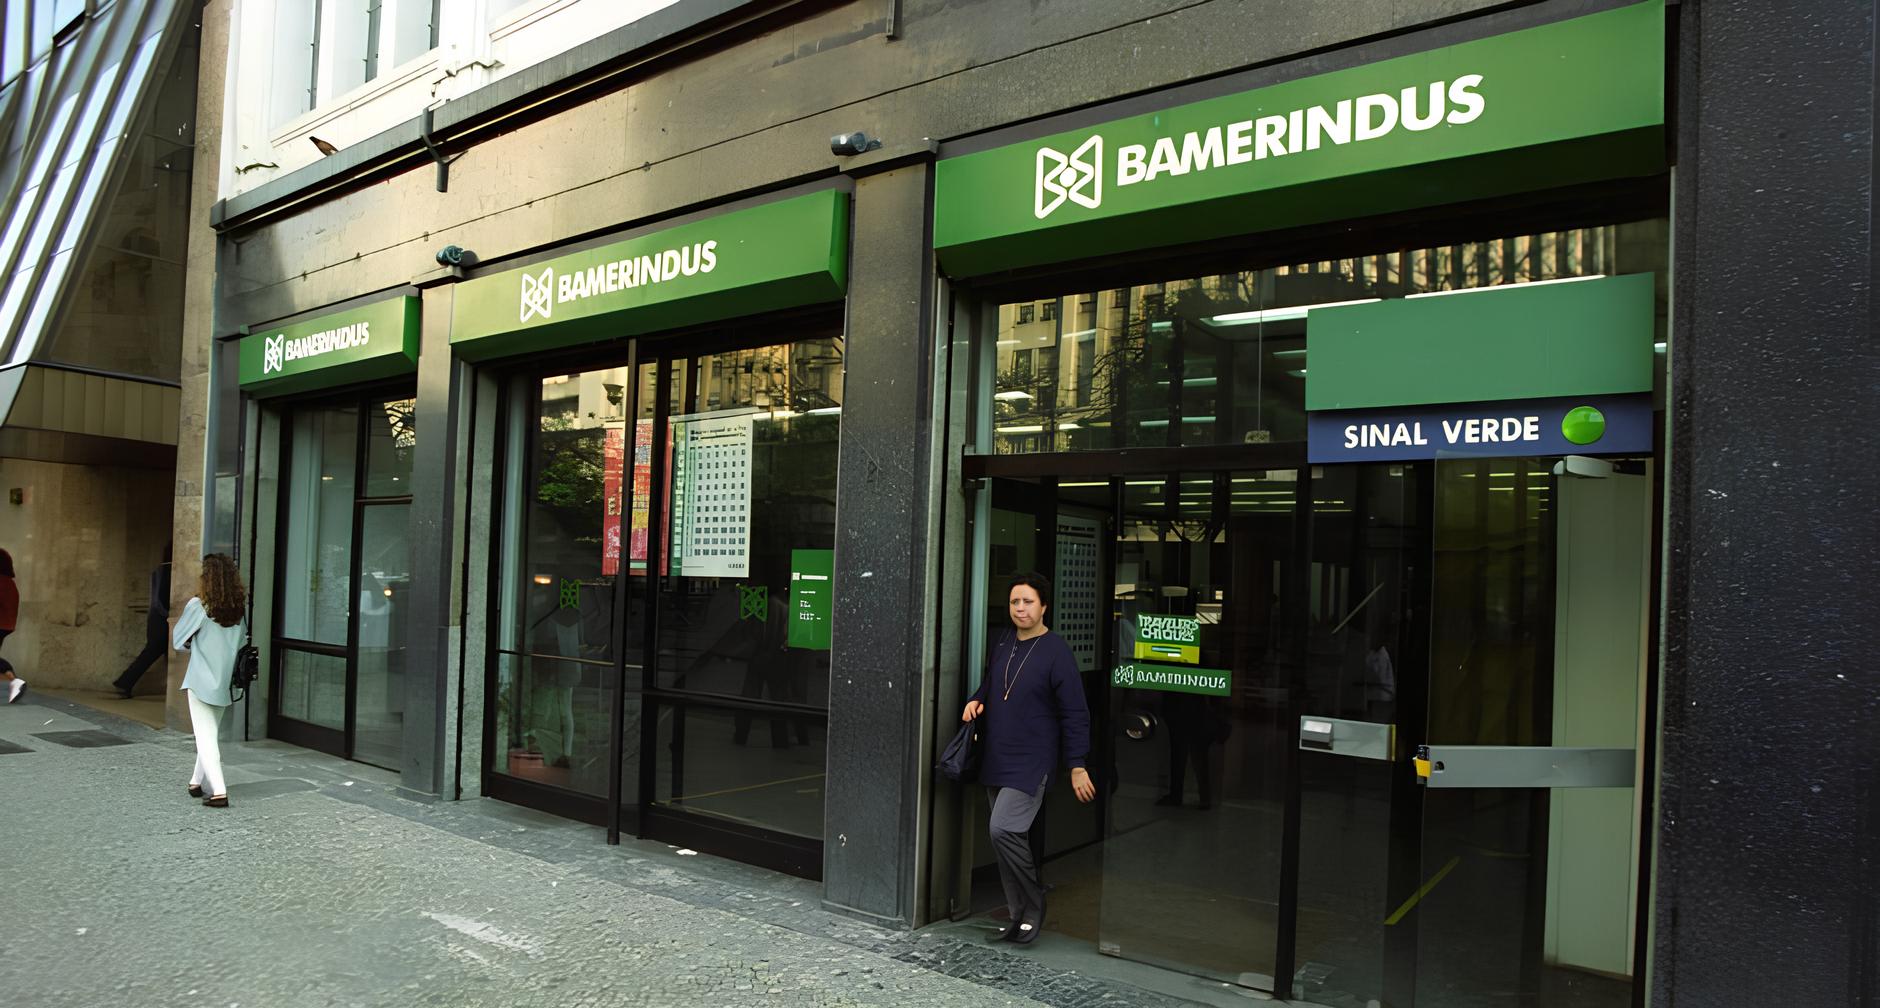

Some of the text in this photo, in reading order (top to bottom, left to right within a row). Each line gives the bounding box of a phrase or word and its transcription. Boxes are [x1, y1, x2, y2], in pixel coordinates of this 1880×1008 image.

[1117, 74, 1485, 187] BAMERINDUS
[558, 240, 718, 304] BAMERINDUS
[1344, 416, 1539, 449] SINAL VERDE
